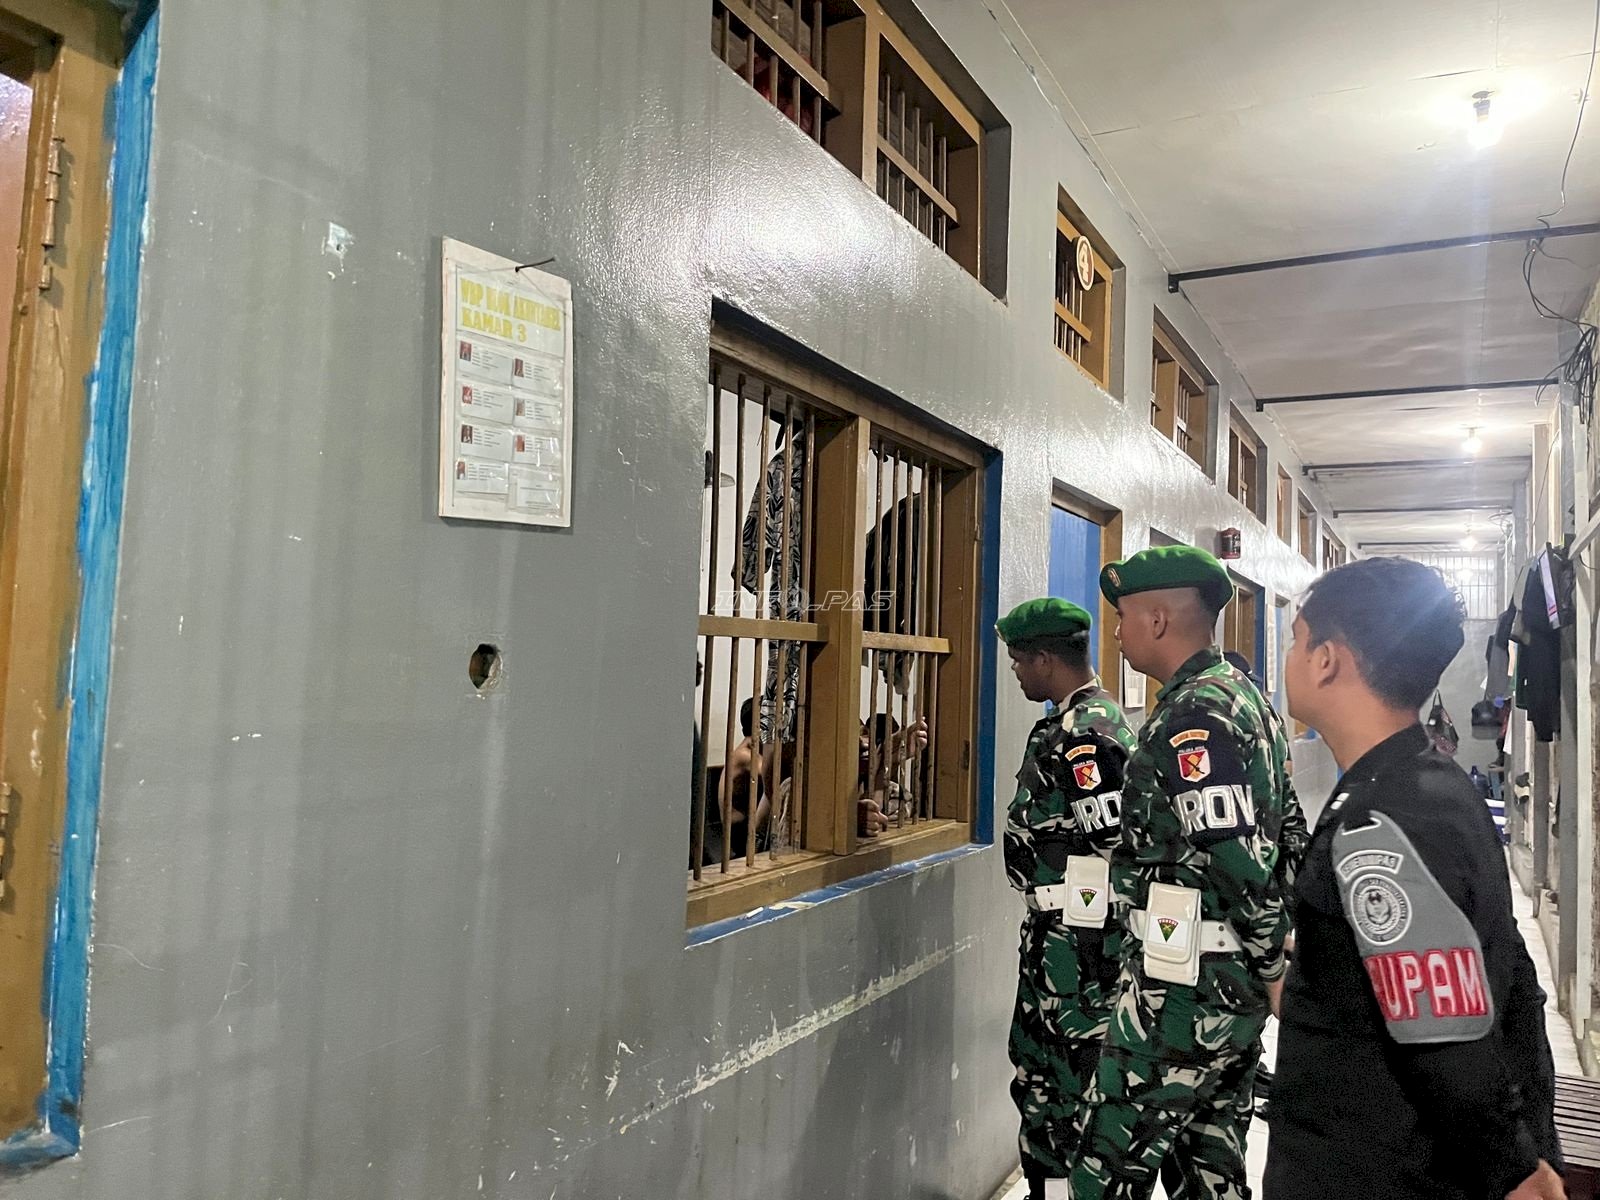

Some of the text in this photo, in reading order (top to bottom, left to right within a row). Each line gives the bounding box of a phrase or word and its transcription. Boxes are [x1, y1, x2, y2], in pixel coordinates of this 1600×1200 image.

[1079, 241, 1090, 283] 4
[462, 306, 527, 343] KAMAR 3
[1172, 784, 1256, 836] ROV
[1366, 949, 1487, 1021] UPAM
